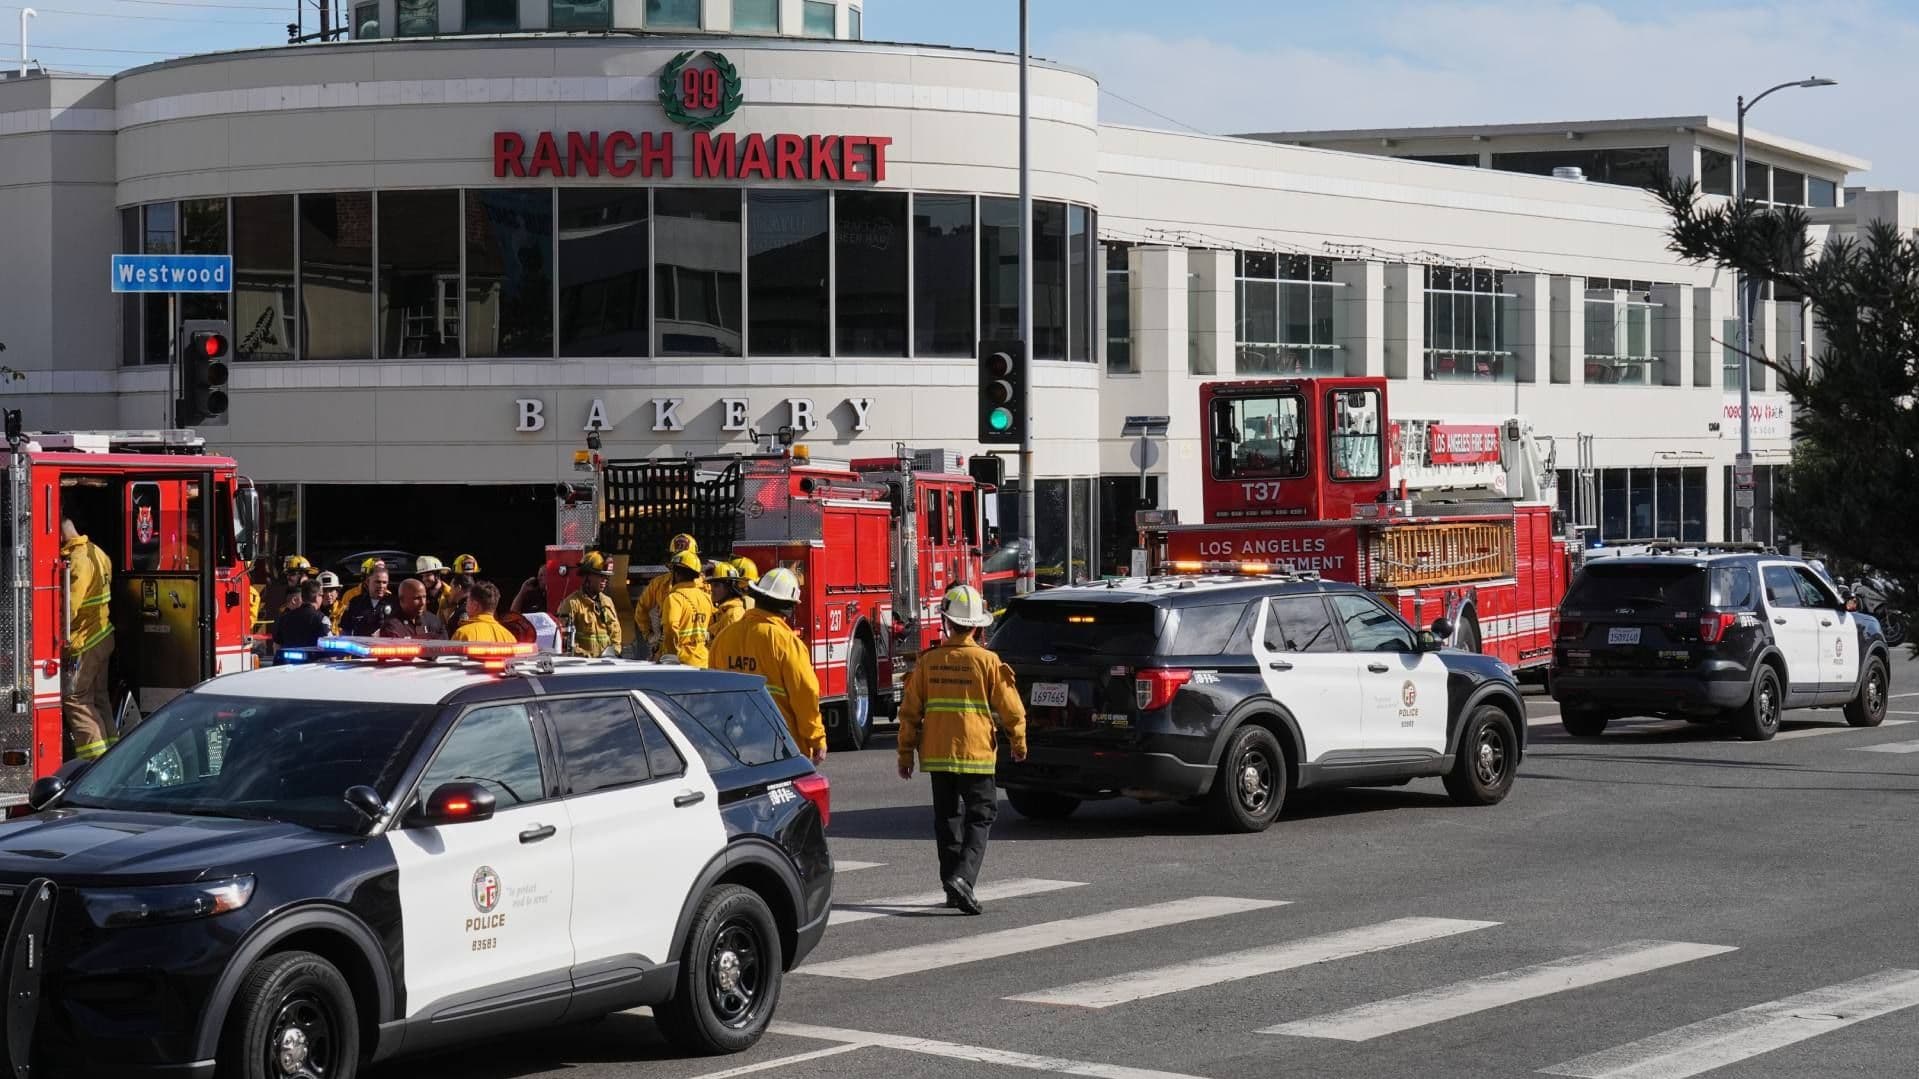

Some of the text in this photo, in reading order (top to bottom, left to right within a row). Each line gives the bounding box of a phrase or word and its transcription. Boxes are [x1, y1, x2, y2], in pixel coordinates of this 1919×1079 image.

[683, 67, 718, 109] 99
[494, 131, 892, 183] RANCH MARKET
[119, 264, 224, 282] Westwood
[515, 398, 875, 432] BAKERY
[1434, 433, 1446, 452] LOS
[1447, 432, 1470, 452] ANGELES
[1471, 432, 1482, 452] FIRE
[1242, 482, 1280, 501] T37
[1200, 538, 1325, 555] LOS ANGELES
[830, 610, 841, 632] 237
[729, 655, 757, 671] LAFD
[1033, 691, 1065, 704] 1697665
[1399, 708, 1419, 717] POLICE
[466, 914, 506, 933] POLICE
